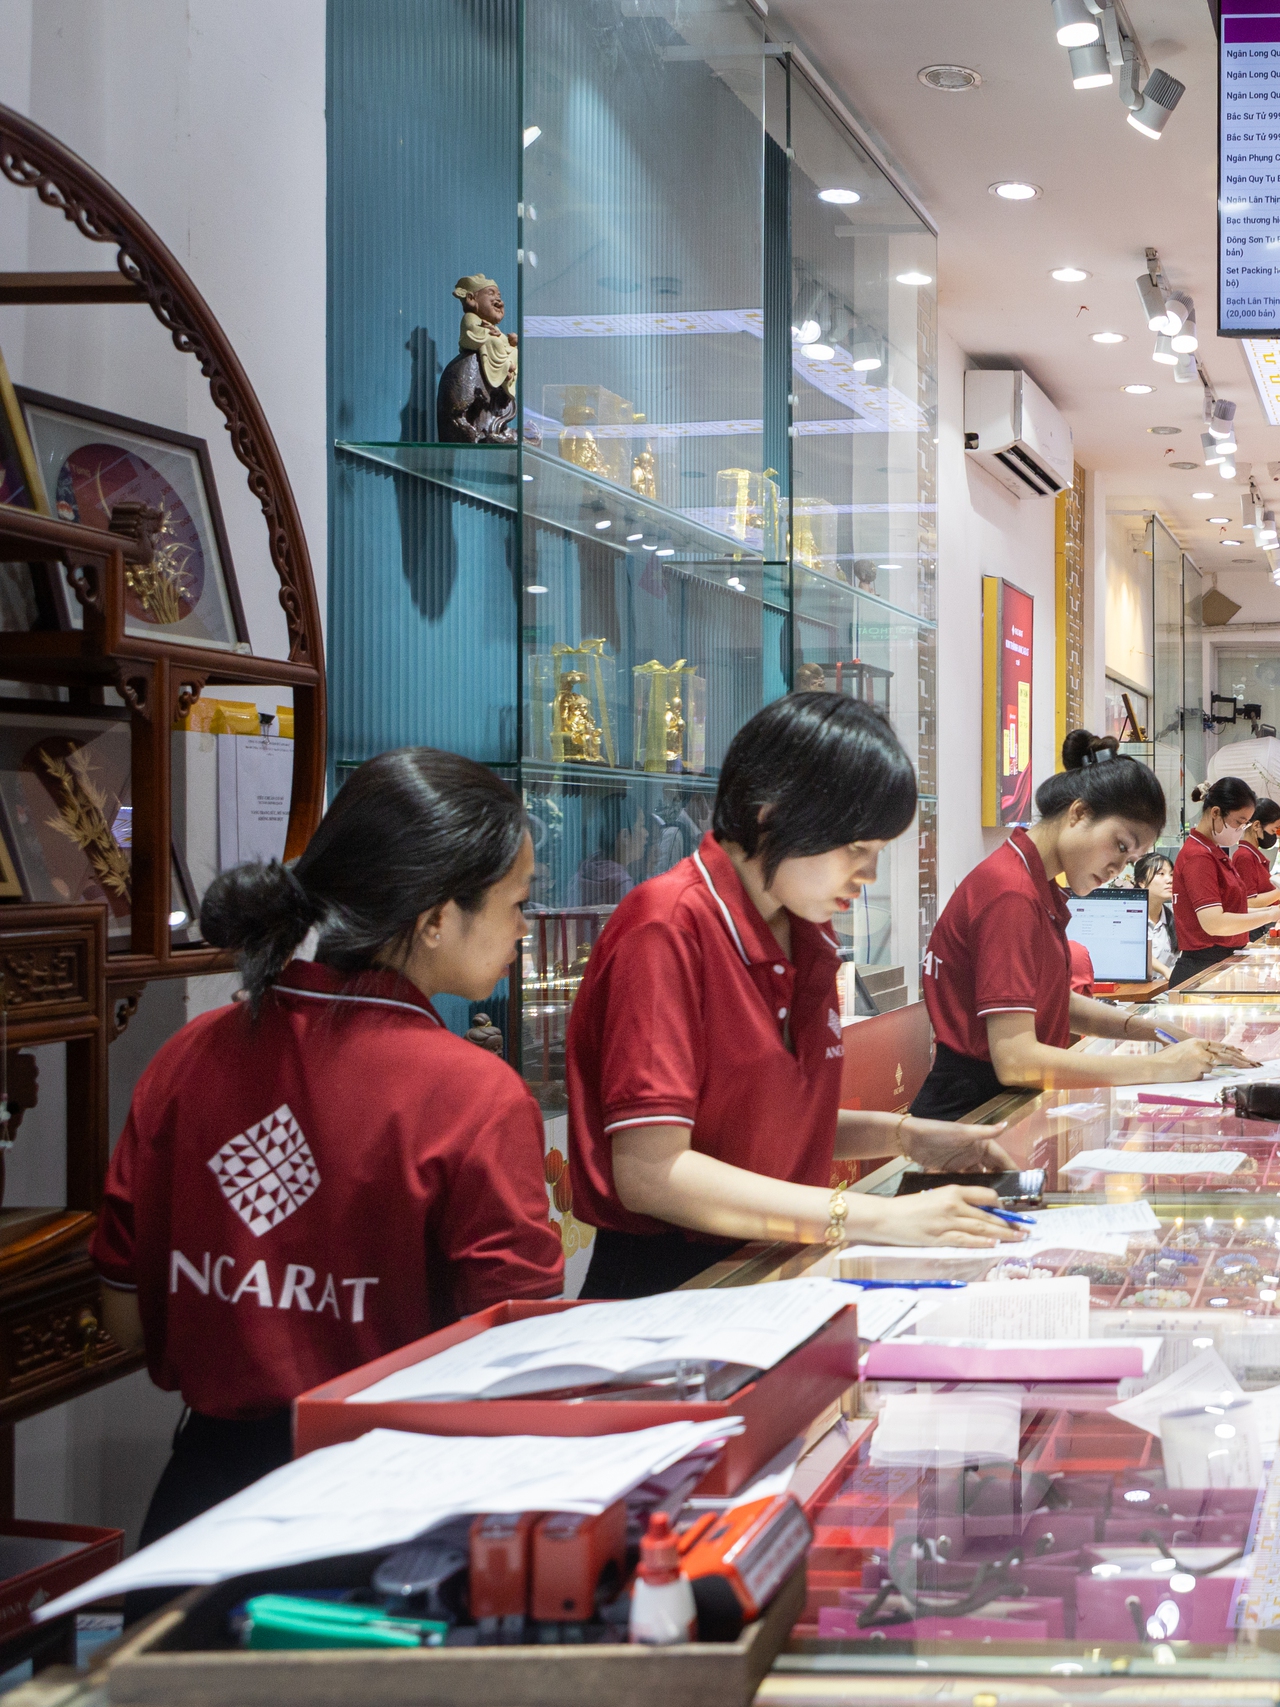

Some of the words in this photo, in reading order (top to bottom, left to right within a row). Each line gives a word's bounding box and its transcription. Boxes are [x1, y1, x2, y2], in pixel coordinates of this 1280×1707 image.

[1227, 49, 1247, 59] Ngân
[1249, 49, 1269, 58] Long
[1226, 216, 1241, 225] Bạc
[1243, 216, 1271, 225] thương
[170, 1250, 379, 1323] NCARAT
